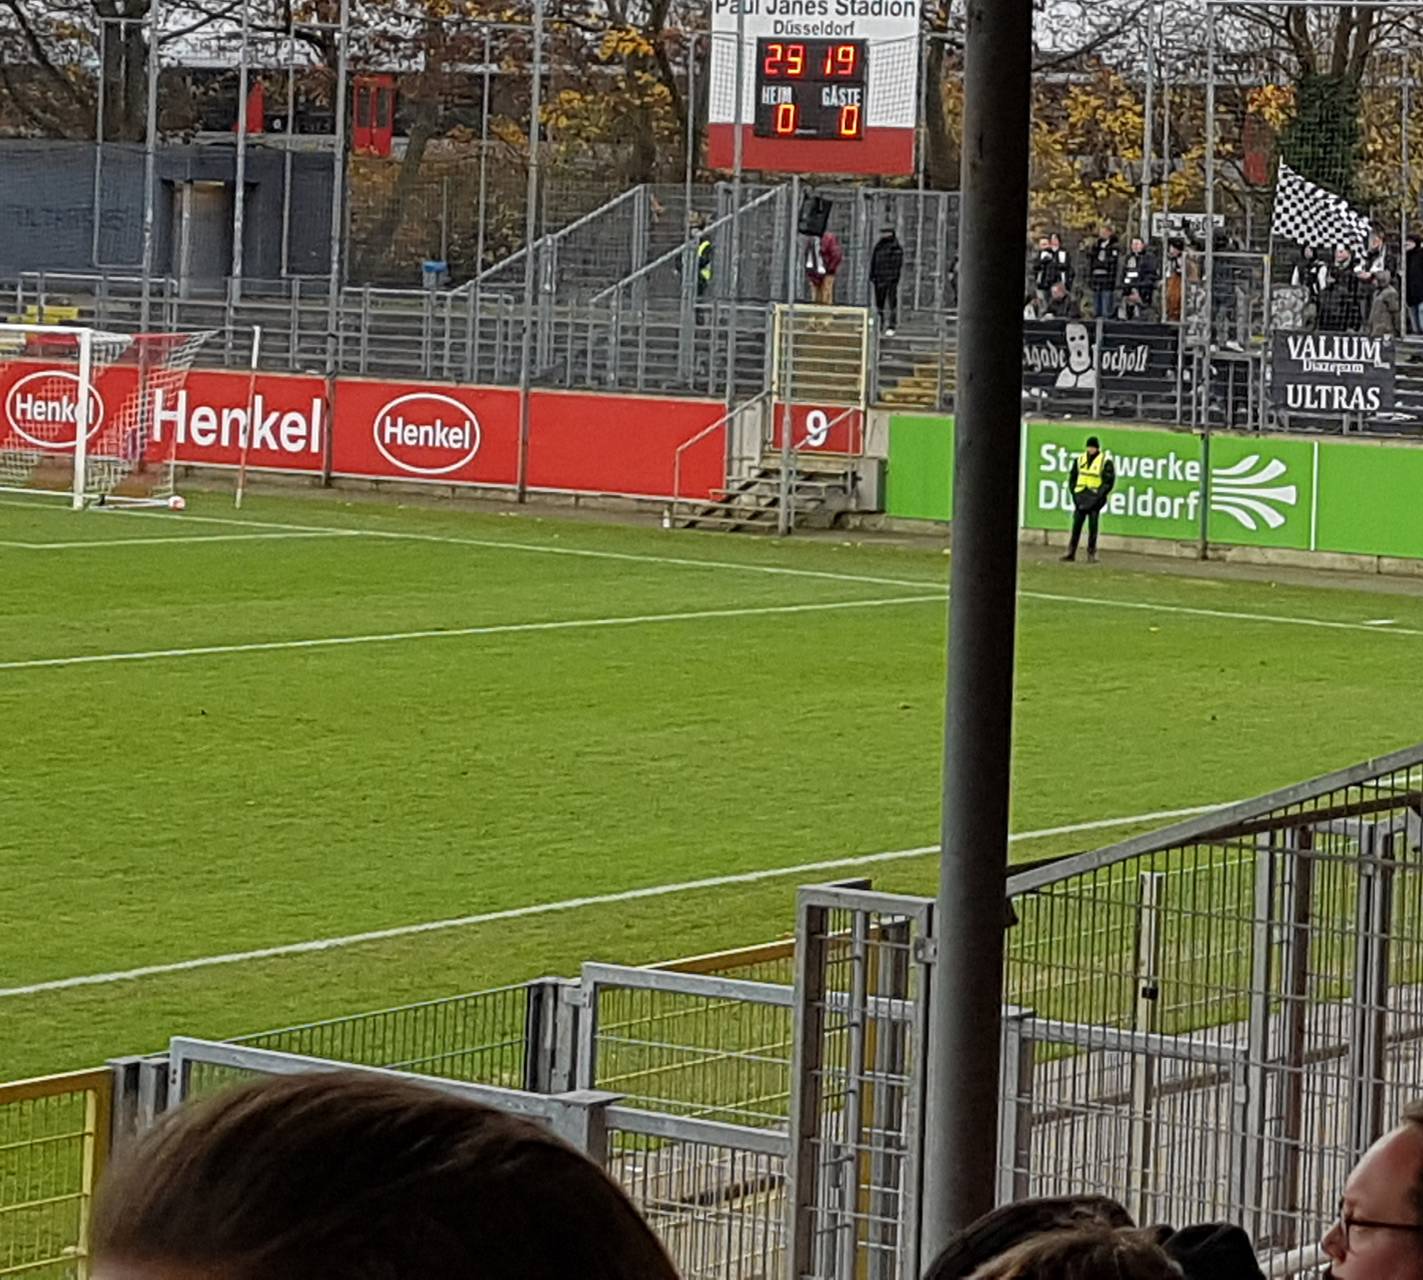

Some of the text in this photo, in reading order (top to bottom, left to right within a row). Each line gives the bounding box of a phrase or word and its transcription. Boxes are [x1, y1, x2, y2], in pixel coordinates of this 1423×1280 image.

[715, 0, 915, 17] Paul Janes Stadion
[773, 20, 855, 36] Düsseldorf
[824, 45, 855, 75] 19
[761, 84, 862, 107] HEIM GÄSTE
[776, 103, 859, 135] 0 0
[1287, 335, 1382, 362] VALIUM
[15, 392, 95, 424] Henkl
[1286, 384, 1381, 411] ULTRAS
[153, 388, 322, 453] Henkel
[384, 416, 471, 450] Henkel
[806, 409, 828, 447] 9
